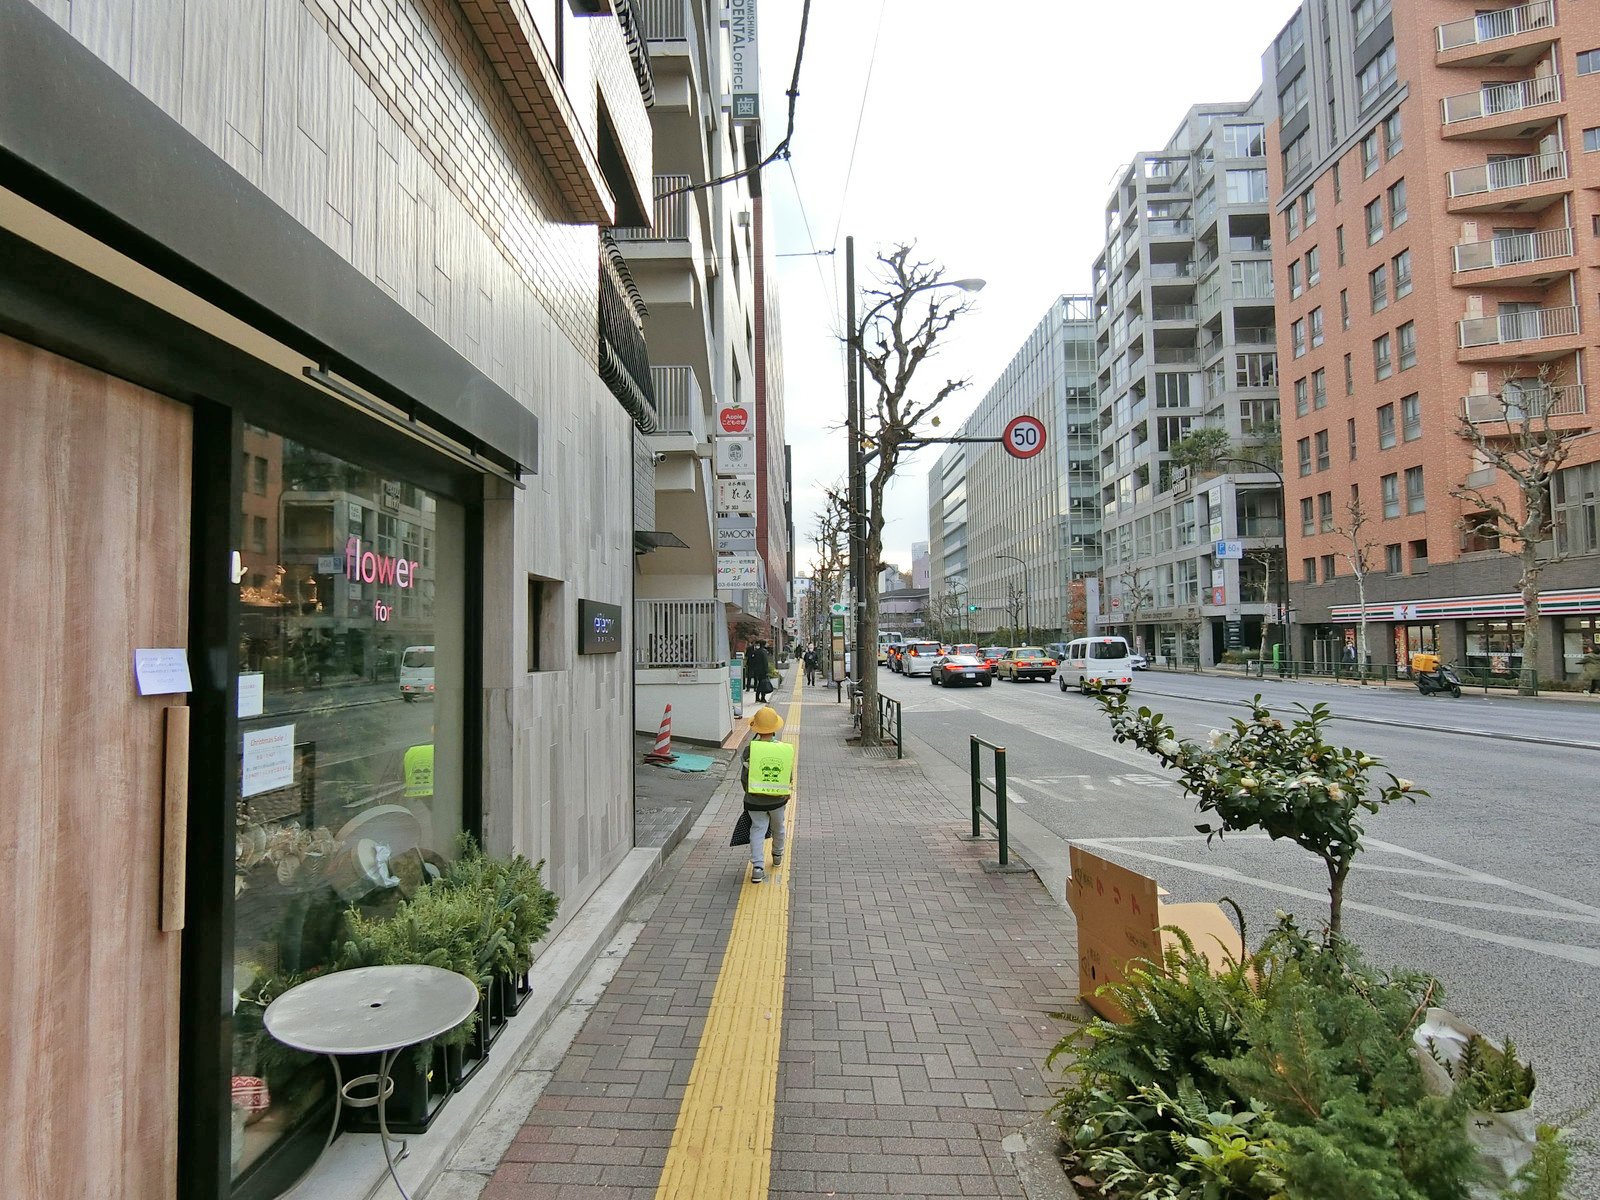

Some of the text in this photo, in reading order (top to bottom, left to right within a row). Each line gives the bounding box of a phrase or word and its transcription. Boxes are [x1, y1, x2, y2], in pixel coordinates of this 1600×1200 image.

[1014, 427, 1037, 446] 50
[719, 529, 755, 539] SIMOON
[719, 541, 729, 549] 2F
[345, 537, 419, 588] flower
[374, 600, 393, 622] for
